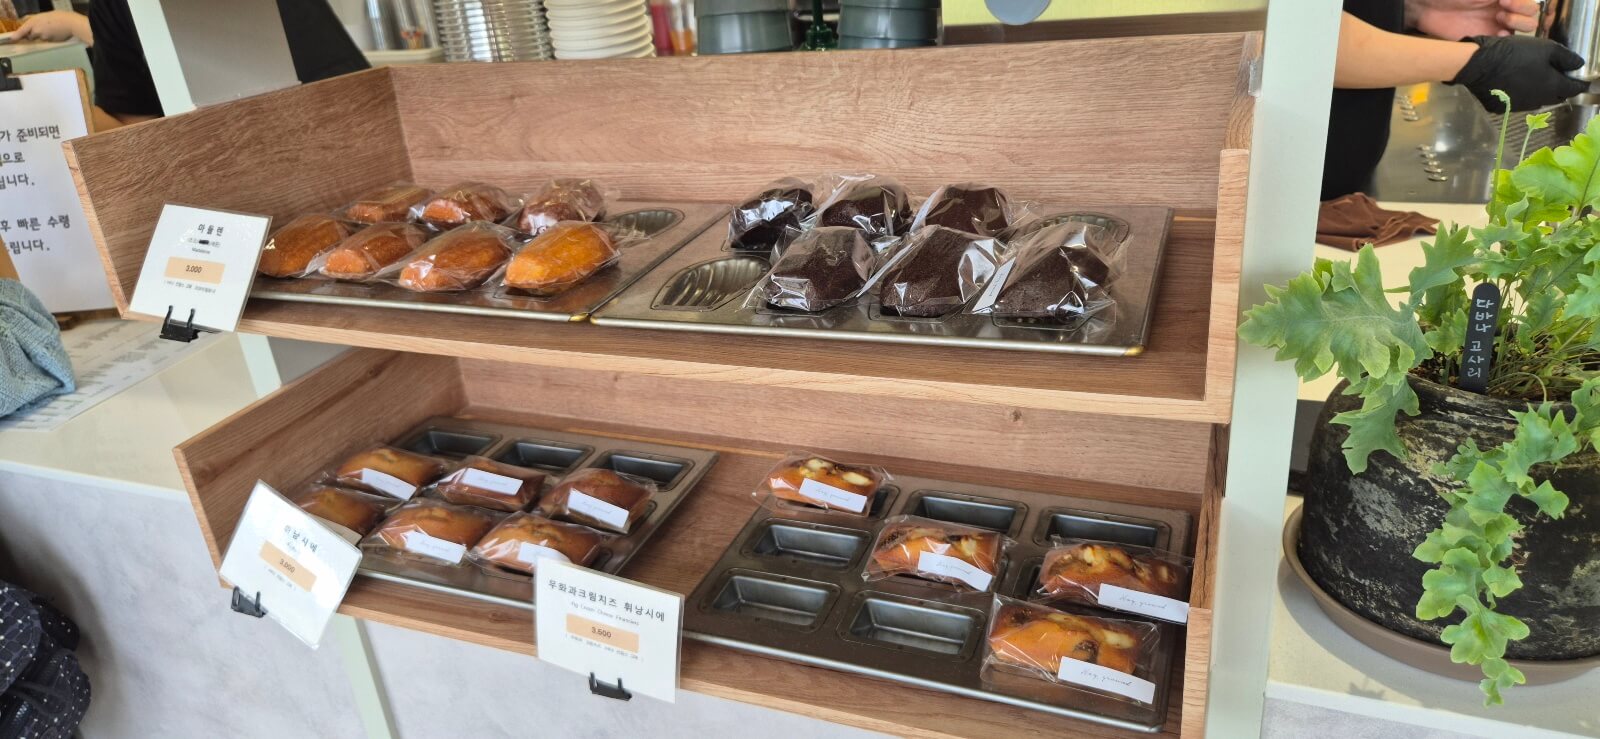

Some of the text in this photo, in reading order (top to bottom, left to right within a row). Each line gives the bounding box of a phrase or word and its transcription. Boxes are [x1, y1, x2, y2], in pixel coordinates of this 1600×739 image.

[16, 124, 61, 143] 준비되면
[0, 152, 25, 166] 으로
[16, 217, 41, 231] 빠른
[47, 214, 71, 229] 수령
[197, 223, 224, 237] 마들렌
[1467, 298, 1494, 378] 다바나 고사리
[548, 579, 665, 622] 무화과크림치즈 휘낭시에
